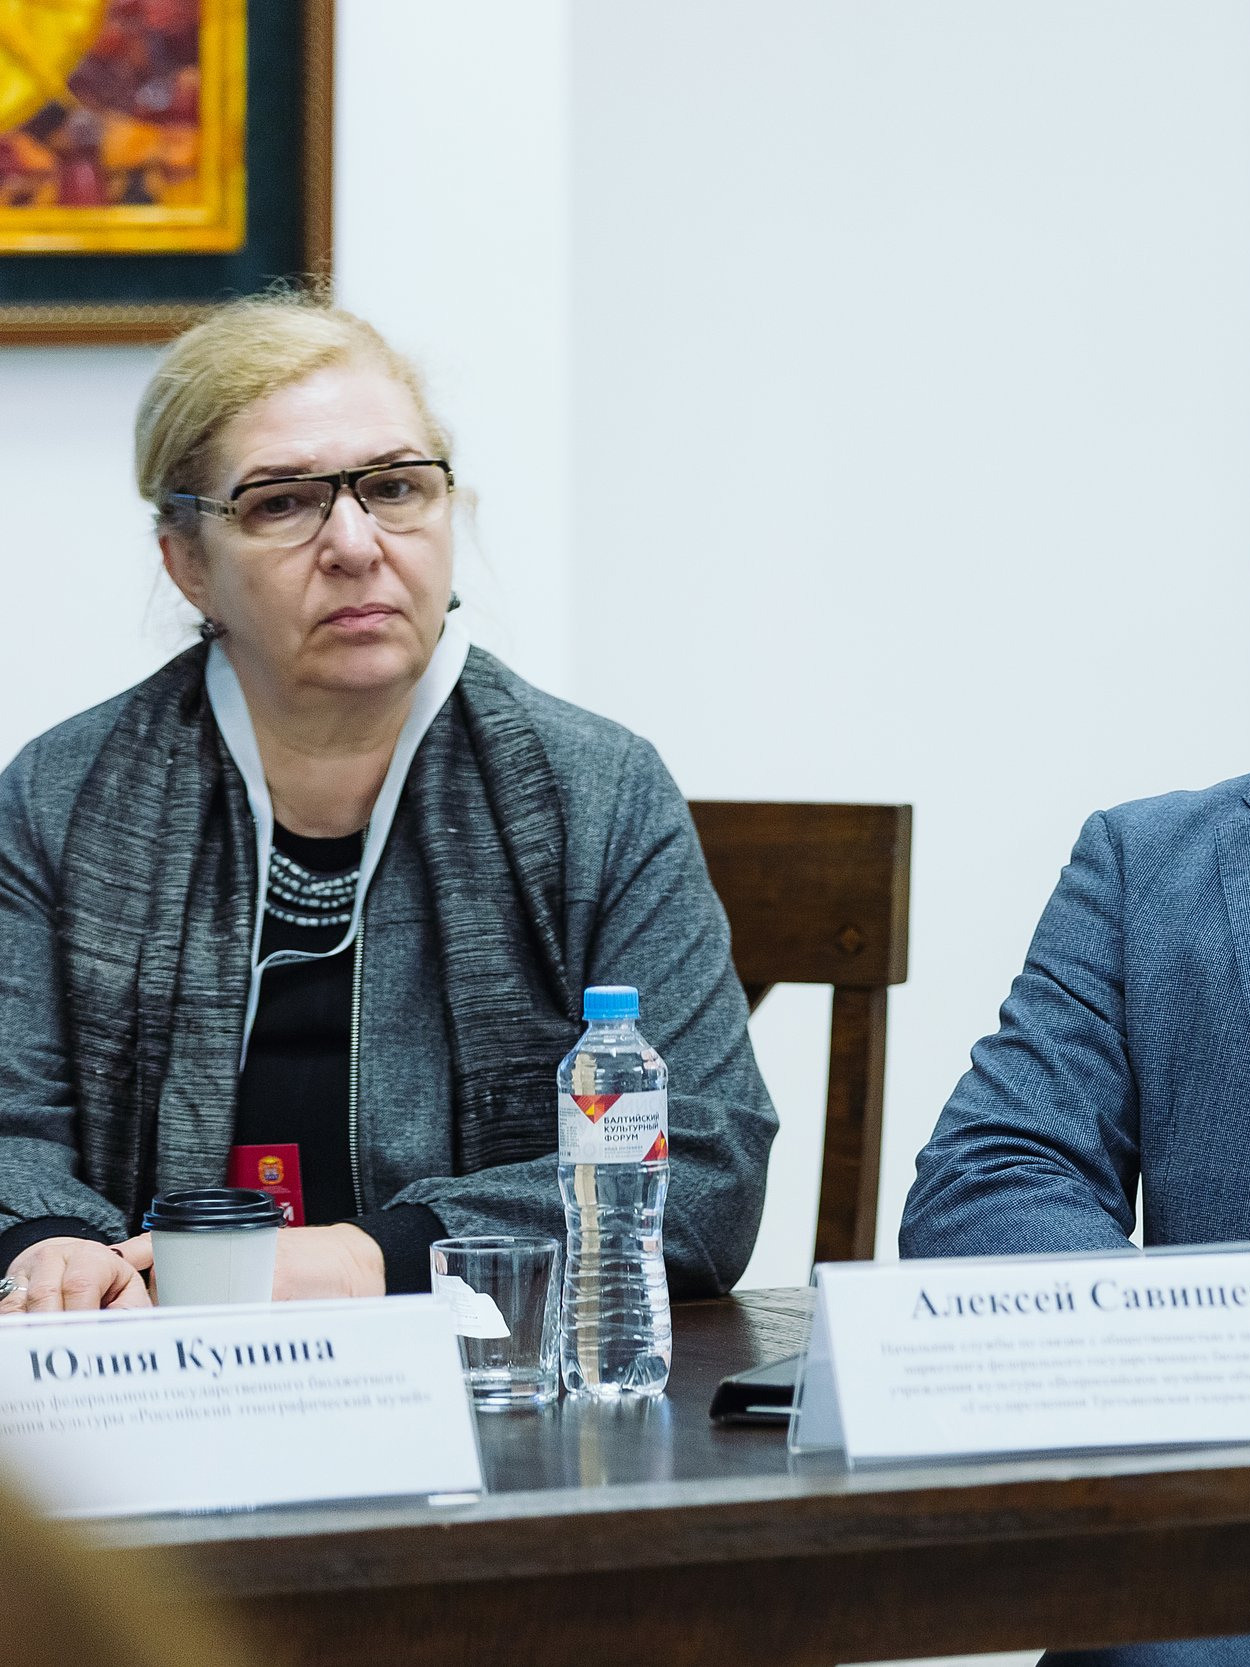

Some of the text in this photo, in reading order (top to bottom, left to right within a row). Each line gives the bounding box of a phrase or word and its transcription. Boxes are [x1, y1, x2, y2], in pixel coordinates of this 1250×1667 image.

[604, 1112, 660, 1124] БАЛТИЙСКИЙ
[604, 1123, 659, 1133] КУЛЬТУРНЫЙ
[604, 1134, 639, 1142] ФОРУМ
[912, 1282, 1076, 1319] Алексей
[29, 1347, 158, 1382] Юлия
